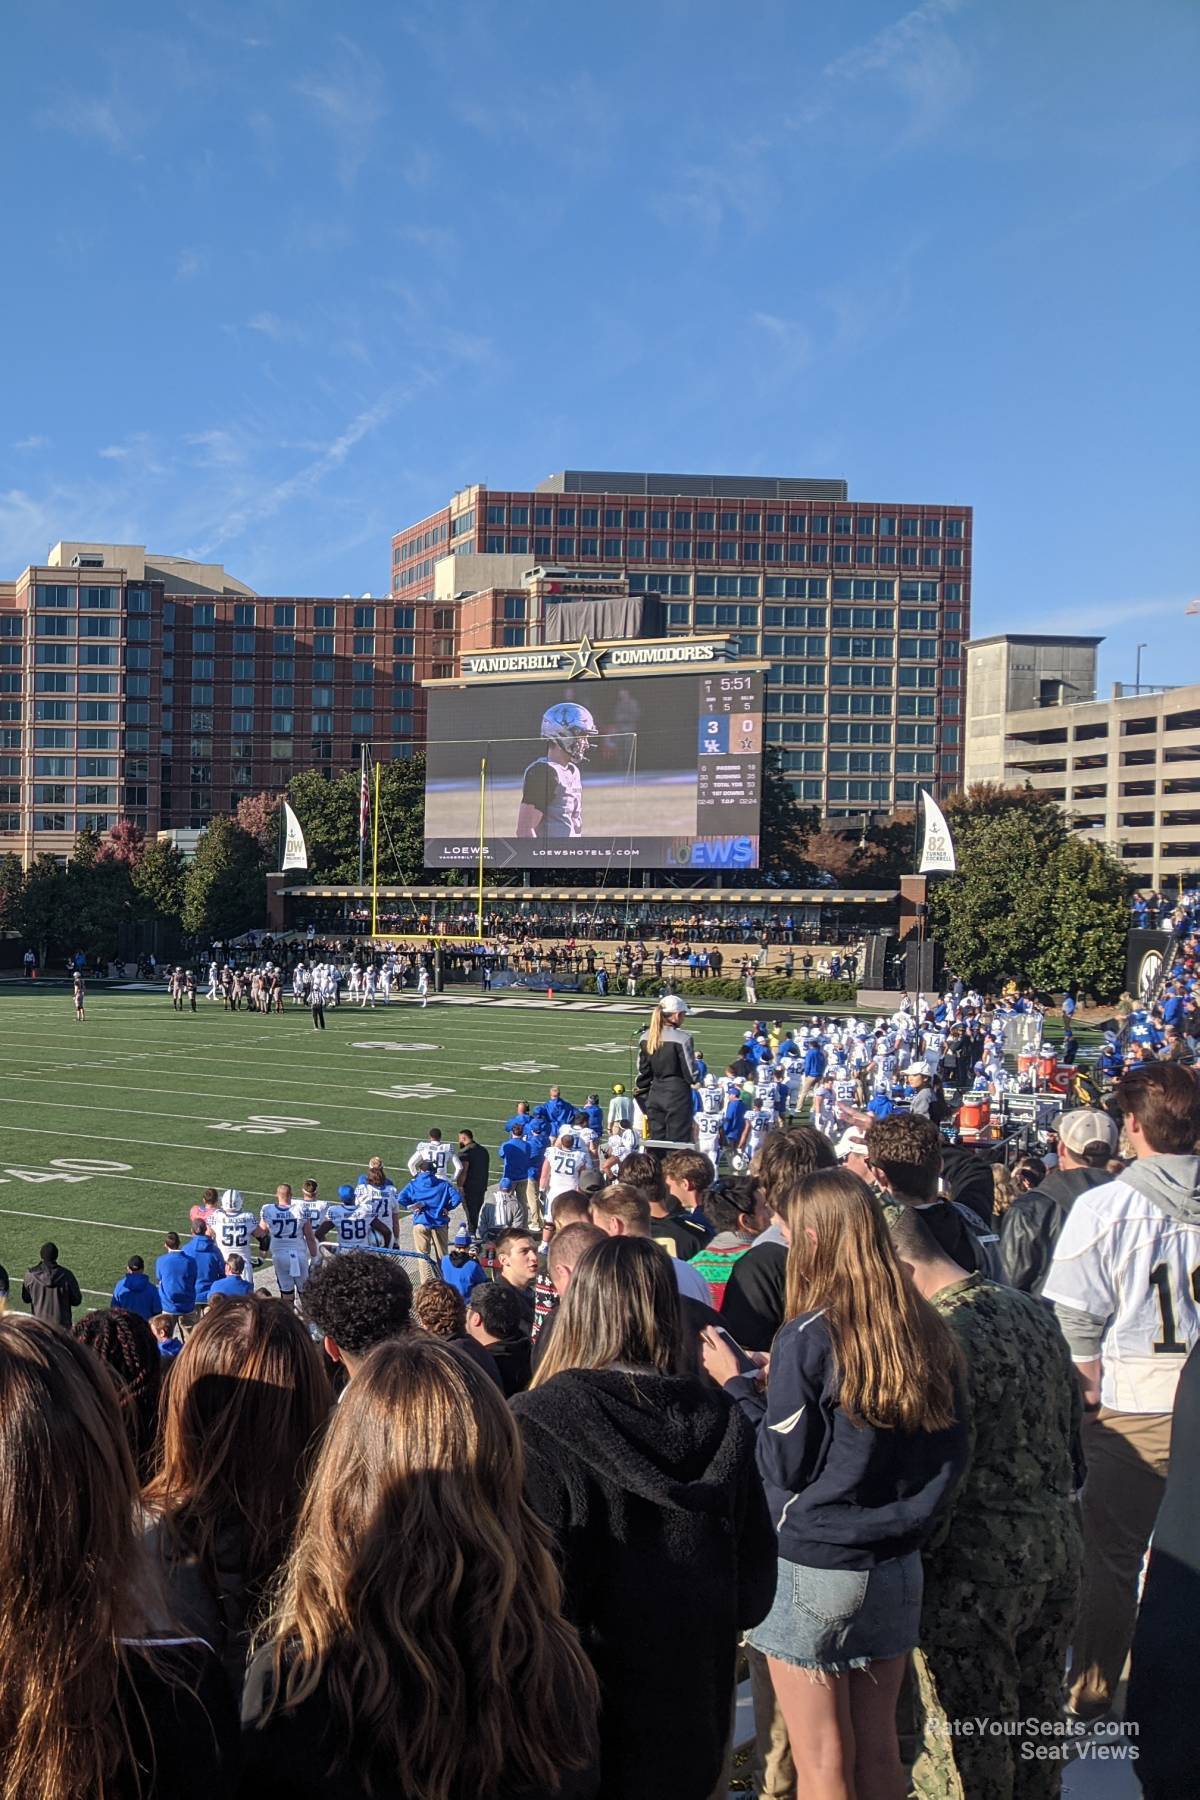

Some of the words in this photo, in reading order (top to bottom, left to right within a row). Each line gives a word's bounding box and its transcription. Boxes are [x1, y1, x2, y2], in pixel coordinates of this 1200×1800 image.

[563, 584, 620, 593] MARRIOTT
[470, 653, 560, 673] VANDERBILT
[577, 650, 591, 668] V
[611, 645, 714, 664] COMMODORES
[720, 677, 751, 690] 5:51
[707, 721, 719, 734] 3
[742, 719, 753, 732] 0
[666, 836, 752, 865] LOEWS
[928, 836, 945, 851] 82
[837, 1086, 854, 1100] 25
[204, 1115, 321, 1134] 50
[700, 1118, 719, 1135] 33
[427, 1150, 446, 1168] 10
[554, 1155, 576, 1176] 79
[3, 1158, 134, 1183] 40
[371, 1198, 389, 1218] 71
[221, 1224, 248, 1247] 52
[272, 1219, 298, 1239] 77
[341, 1218, 367, 1240] 68
[1149, 1261, 1200, 1355] 1
